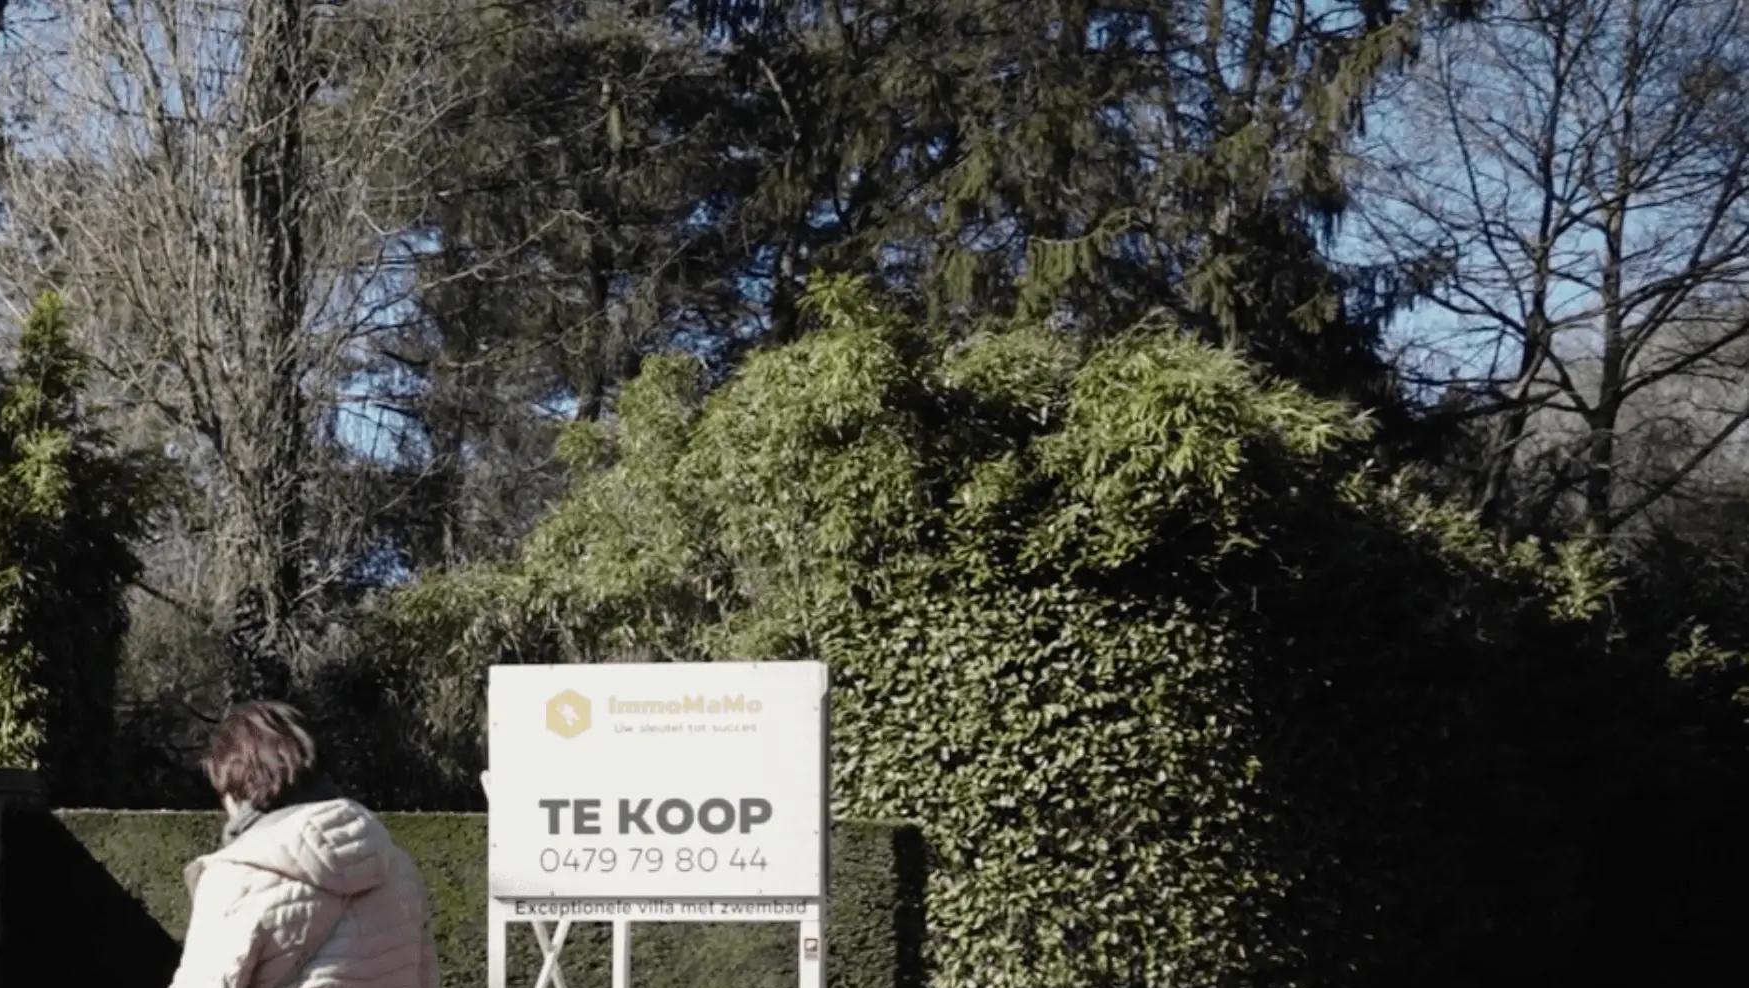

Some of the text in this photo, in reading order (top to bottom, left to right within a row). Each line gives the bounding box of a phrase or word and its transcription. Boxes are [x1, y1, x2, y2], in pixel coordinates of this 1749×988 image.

[614, 723, 634, 734] Uw
[688, 723, 707, 734] tot
[539, 797, 773, 835] TE KOOP
[540, 847, 768, 873] 0479 79 80 44
[514, 900, 807, 917] Exceptionele villa met zwembad
